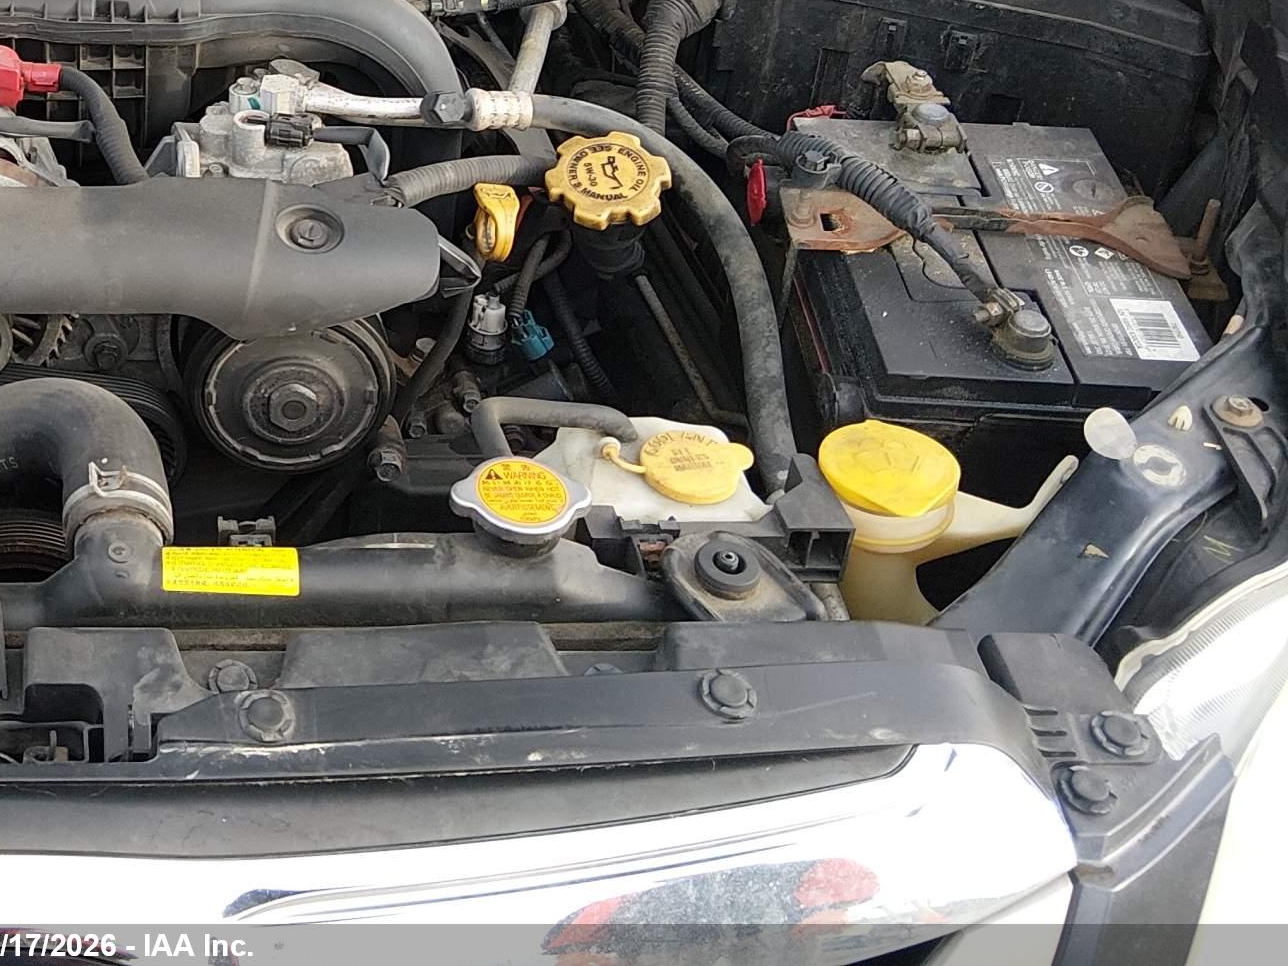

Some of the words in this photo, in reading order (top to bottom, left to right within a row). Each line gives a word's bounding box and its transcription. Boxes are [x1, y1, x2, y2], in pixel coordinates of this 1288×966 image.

[617, 147, 646, 176] ENGINE
[629, 178, 644, 192] OIL
[580, 187, 628, 201] MANUAL
[503, 472, 546, 480] WARNING
